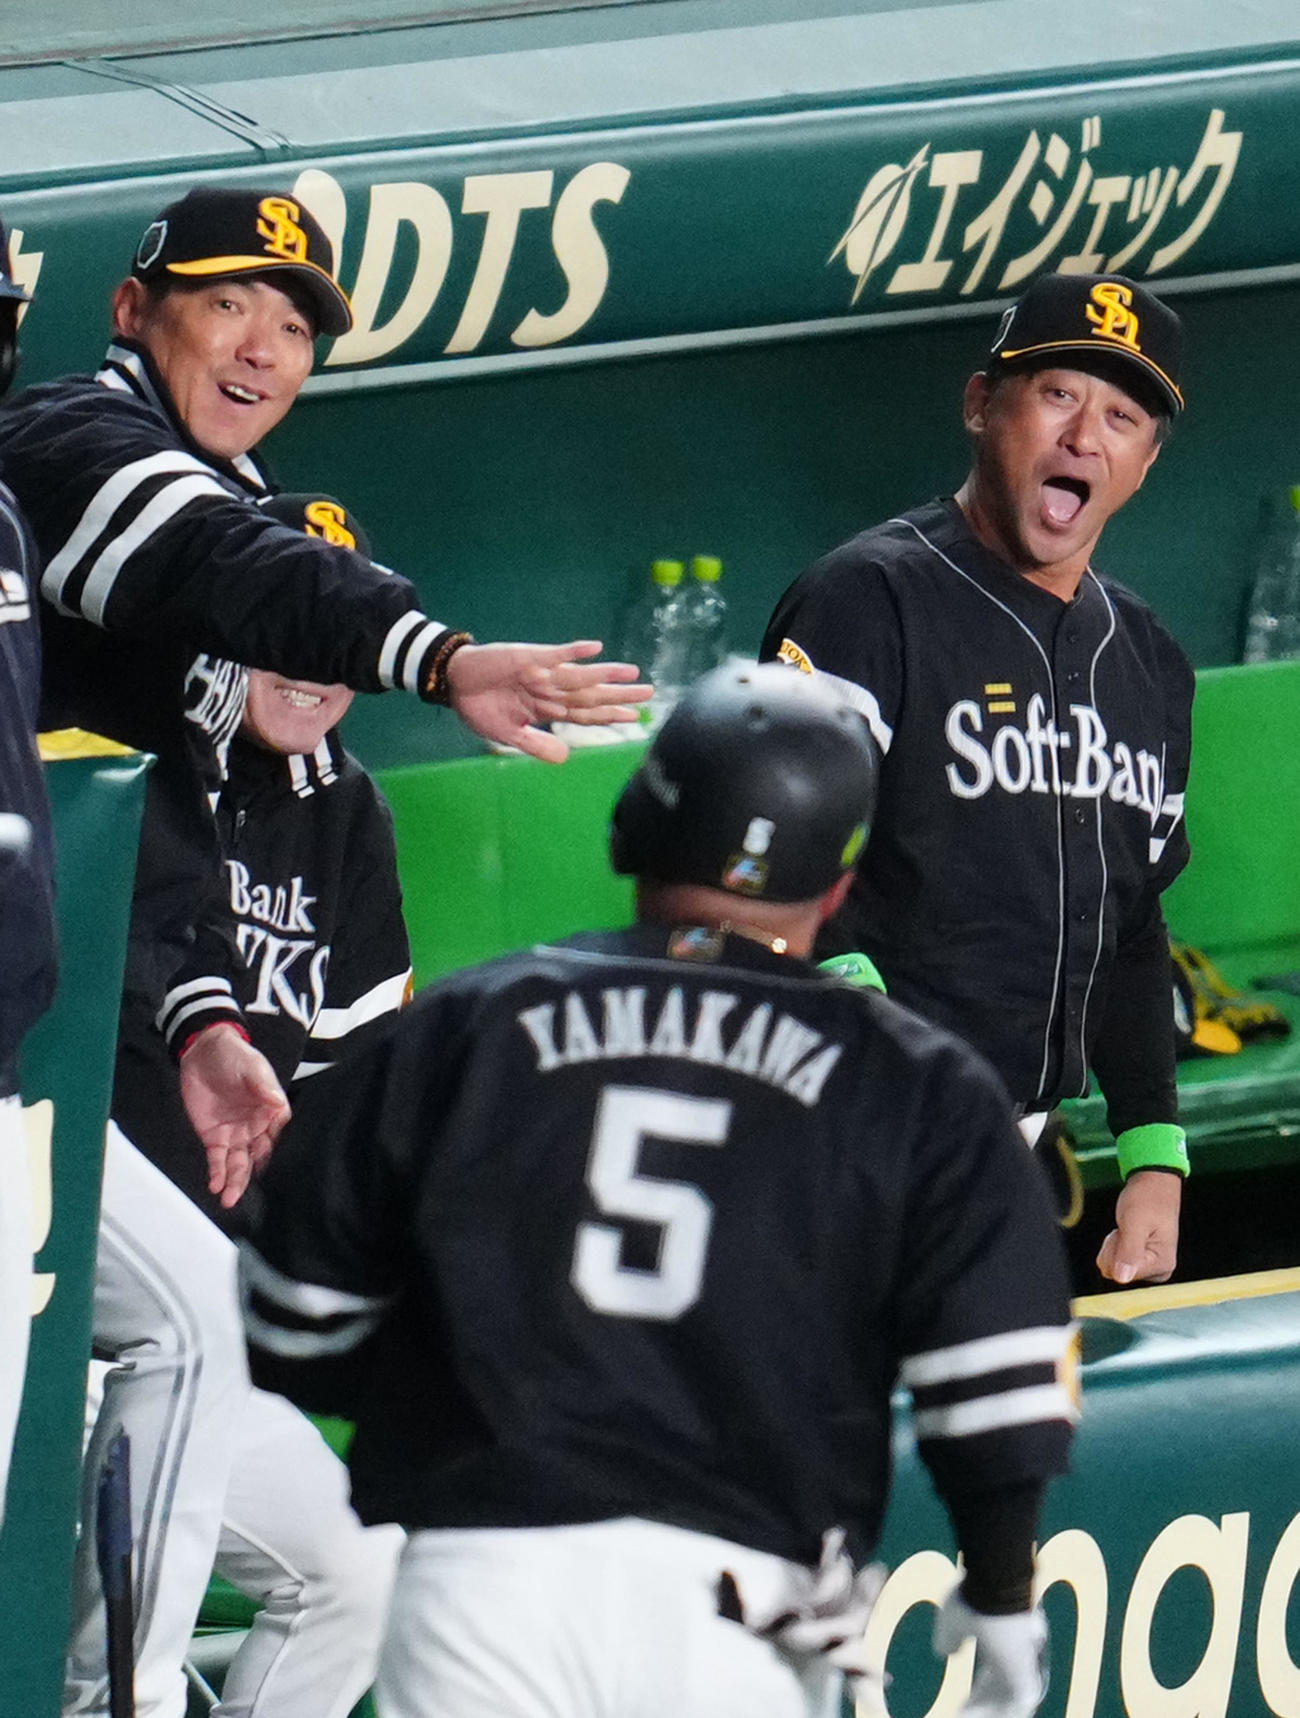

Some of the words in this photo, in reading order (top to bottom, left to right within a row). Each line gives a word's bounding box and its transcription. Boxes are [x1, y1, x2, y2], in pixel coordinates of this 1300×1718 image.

[885, 108, 1243, 296] エイジェック
[225, 859, 318, 933] Bank
[516, 985, 845, 1108] YAMAKAWA
[569, 1083, 733, 1322] 5
